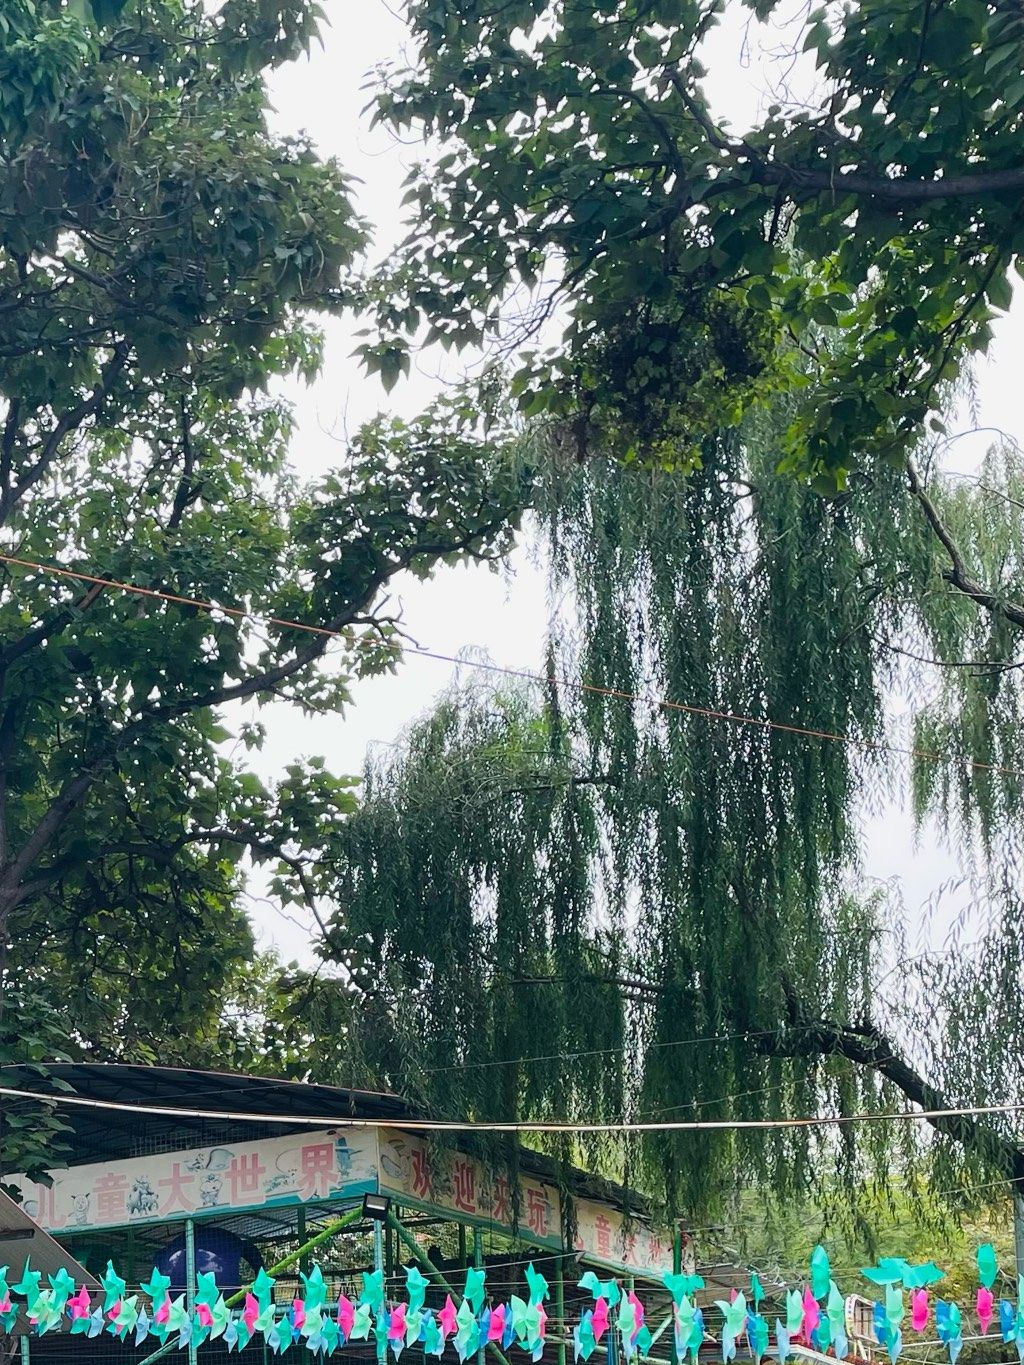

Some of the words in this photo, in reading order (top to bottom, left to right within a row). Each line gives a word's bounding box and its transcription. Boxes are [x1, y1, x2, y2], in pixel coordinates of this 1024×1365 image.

[35, 1142, 339, 1228] 儿童大世界
[410, 1147, 549, 1237] 欢迎来玩
